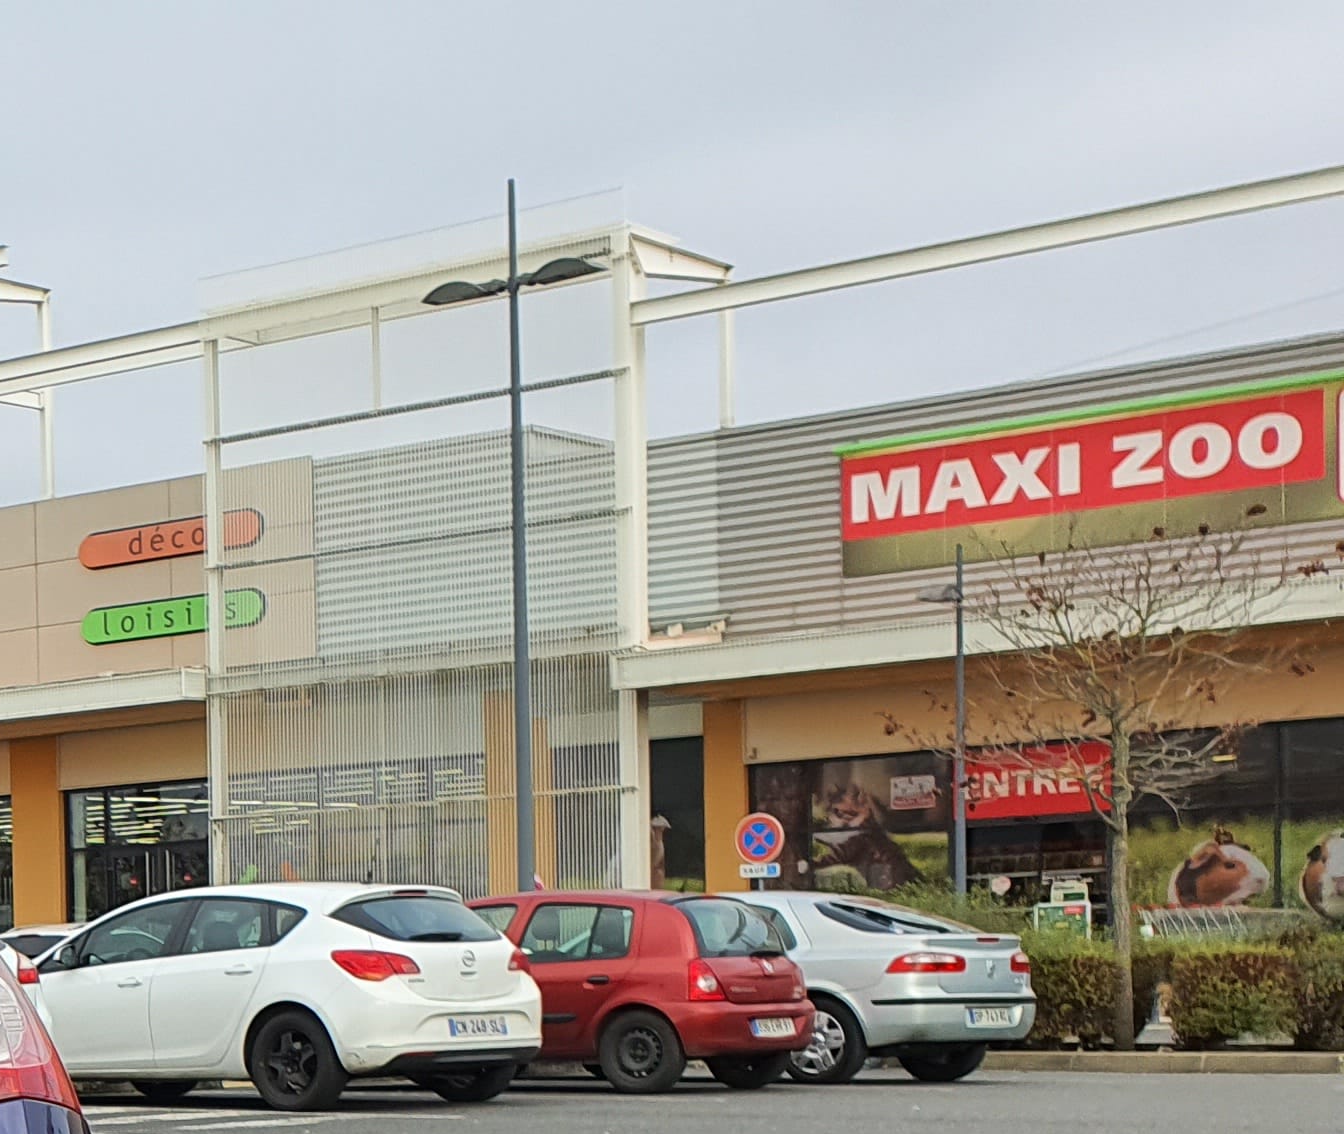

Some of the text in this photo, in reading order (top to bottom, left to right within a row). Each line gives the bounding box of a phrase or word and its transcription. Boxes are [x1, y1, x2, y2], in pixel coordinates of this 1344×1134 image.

[850, 411, 1303, 525] MAXI ZOO
[128, 526, 205, 556] déco
[103, 601, 237, 636] loisis
